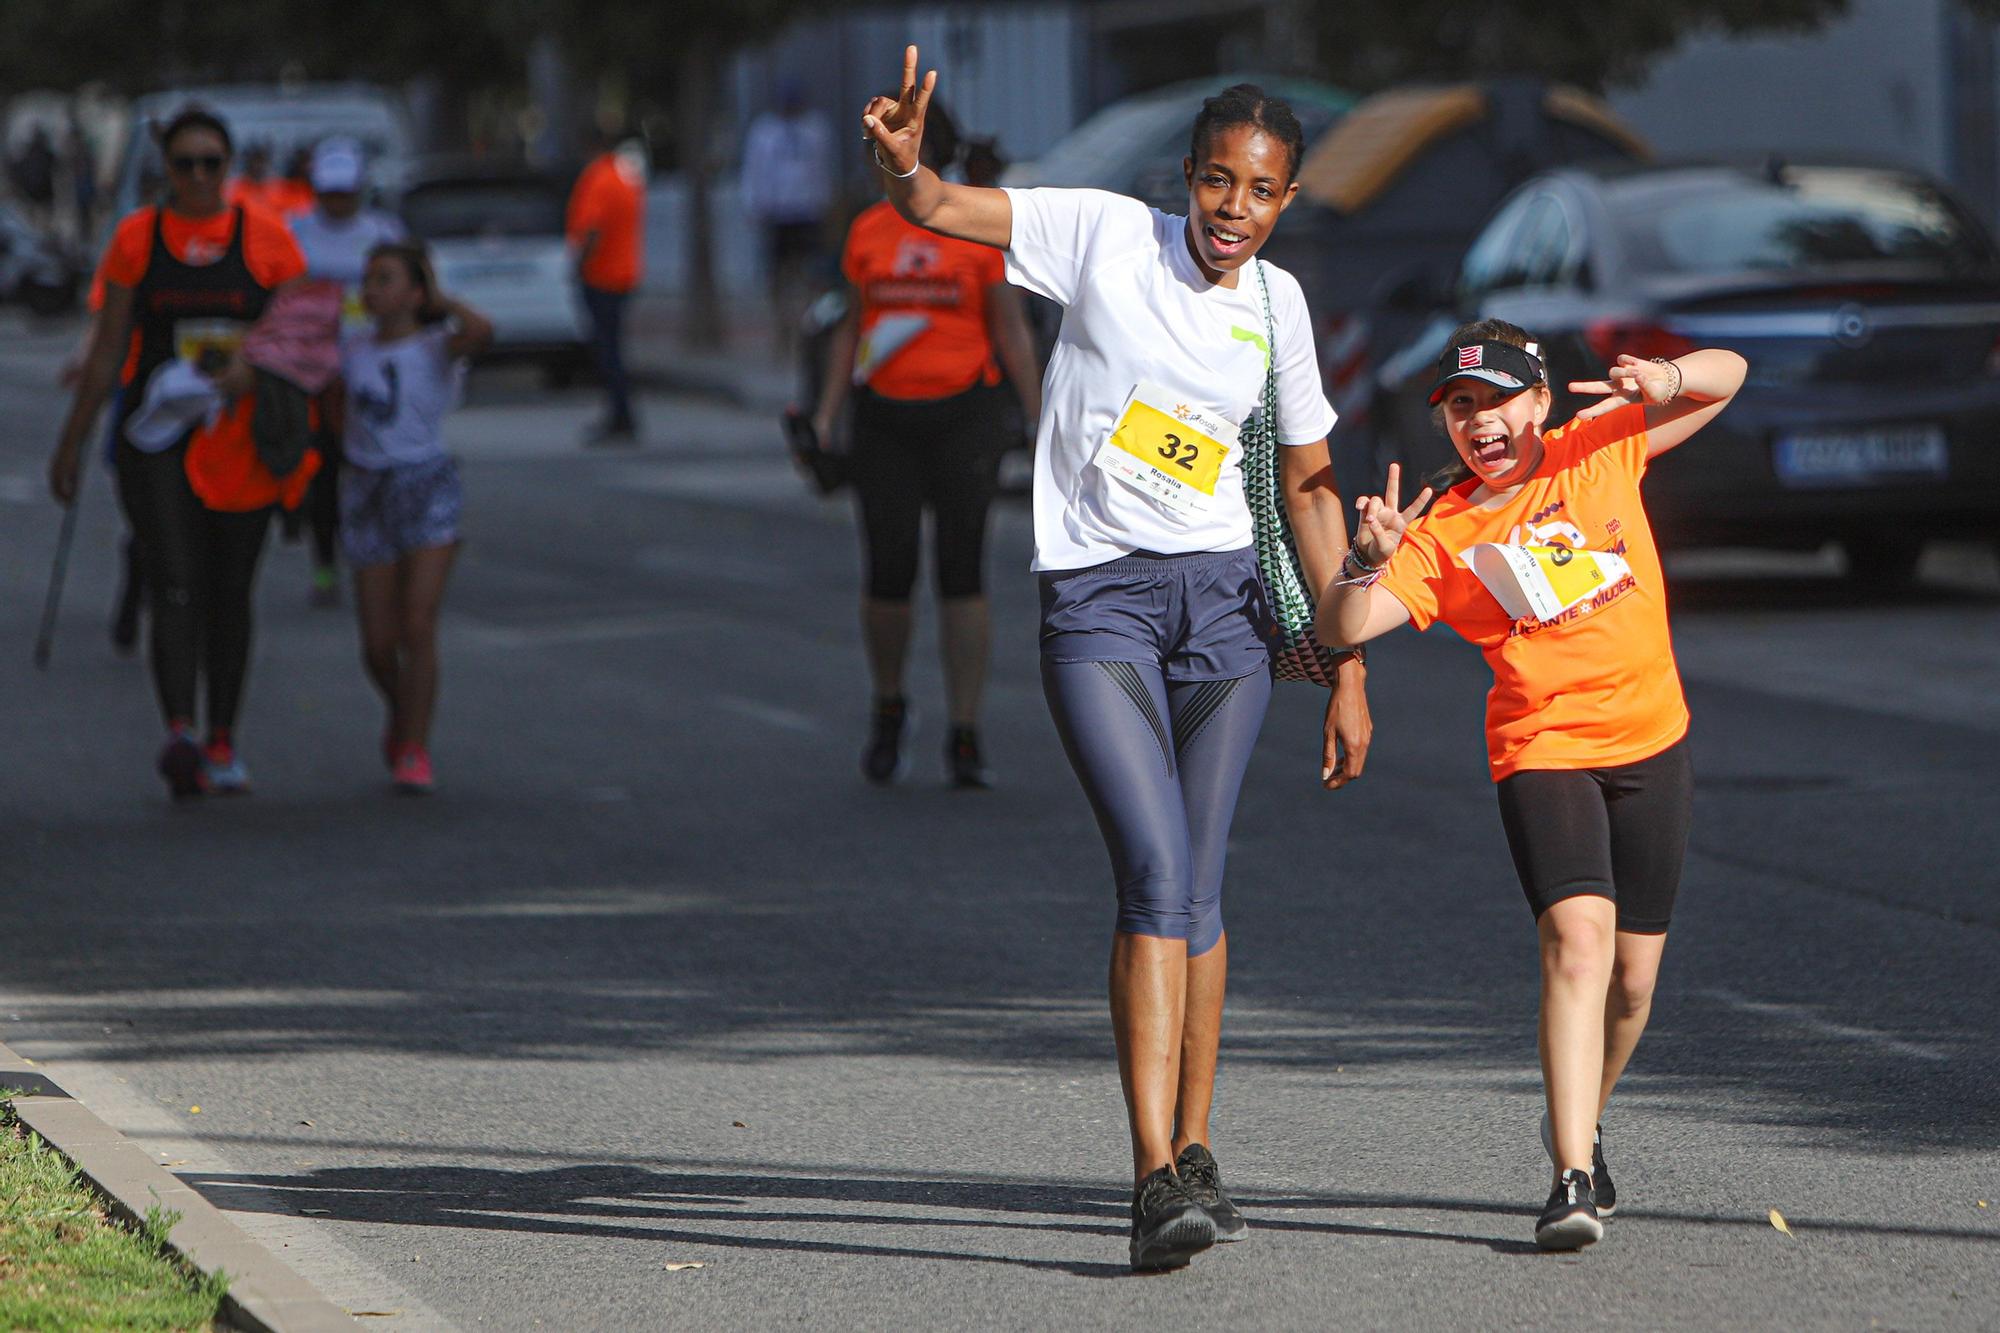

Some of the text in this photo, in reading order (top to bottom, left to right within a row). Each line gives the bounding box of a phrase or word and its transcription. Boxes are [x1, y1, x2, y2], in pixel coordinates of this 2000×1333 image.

[1158, 433, 1198, 471] 32
[1150, 467, 1182, 490] Rosalia
[1591, 575, 1637, 609] MUJER
